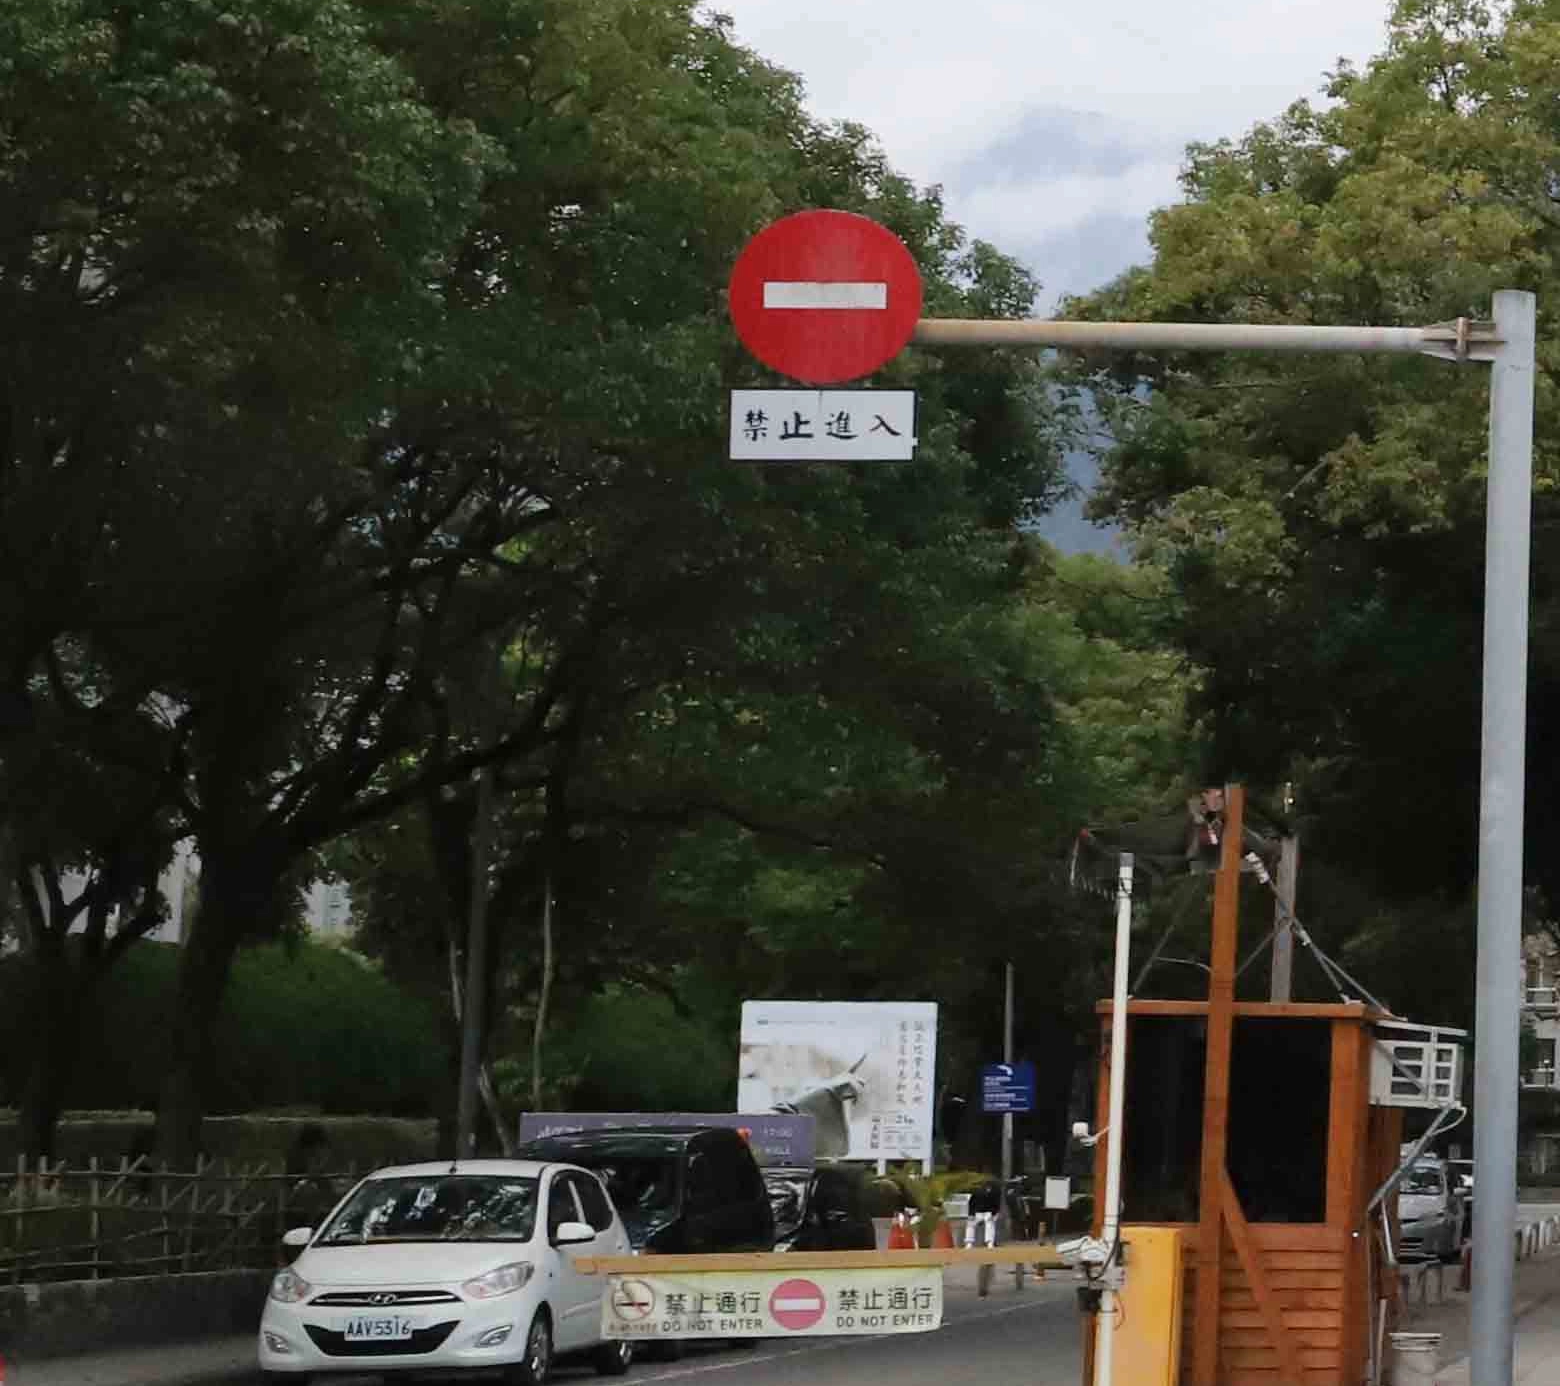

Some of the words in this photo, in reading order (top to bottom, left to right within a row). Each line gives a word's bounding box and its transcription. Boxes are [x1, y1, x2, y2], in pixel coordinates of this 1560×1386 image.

[743, 410, 903, 442] 禁止進入
[664, 1291, 762, 1315] 禁止通行
[838, 1287, 934, 1312] 禁止通行
[662, 1320, 681, 1333] DO
[688, 1319, 714, 1332] NOT
[720, 1318, 763, 1332] ENTER
[836, 1316, 855, 1327] DO
[861, 1315, 886, 1327] NOT
[893, 1314, 934, 1326] ENTER
